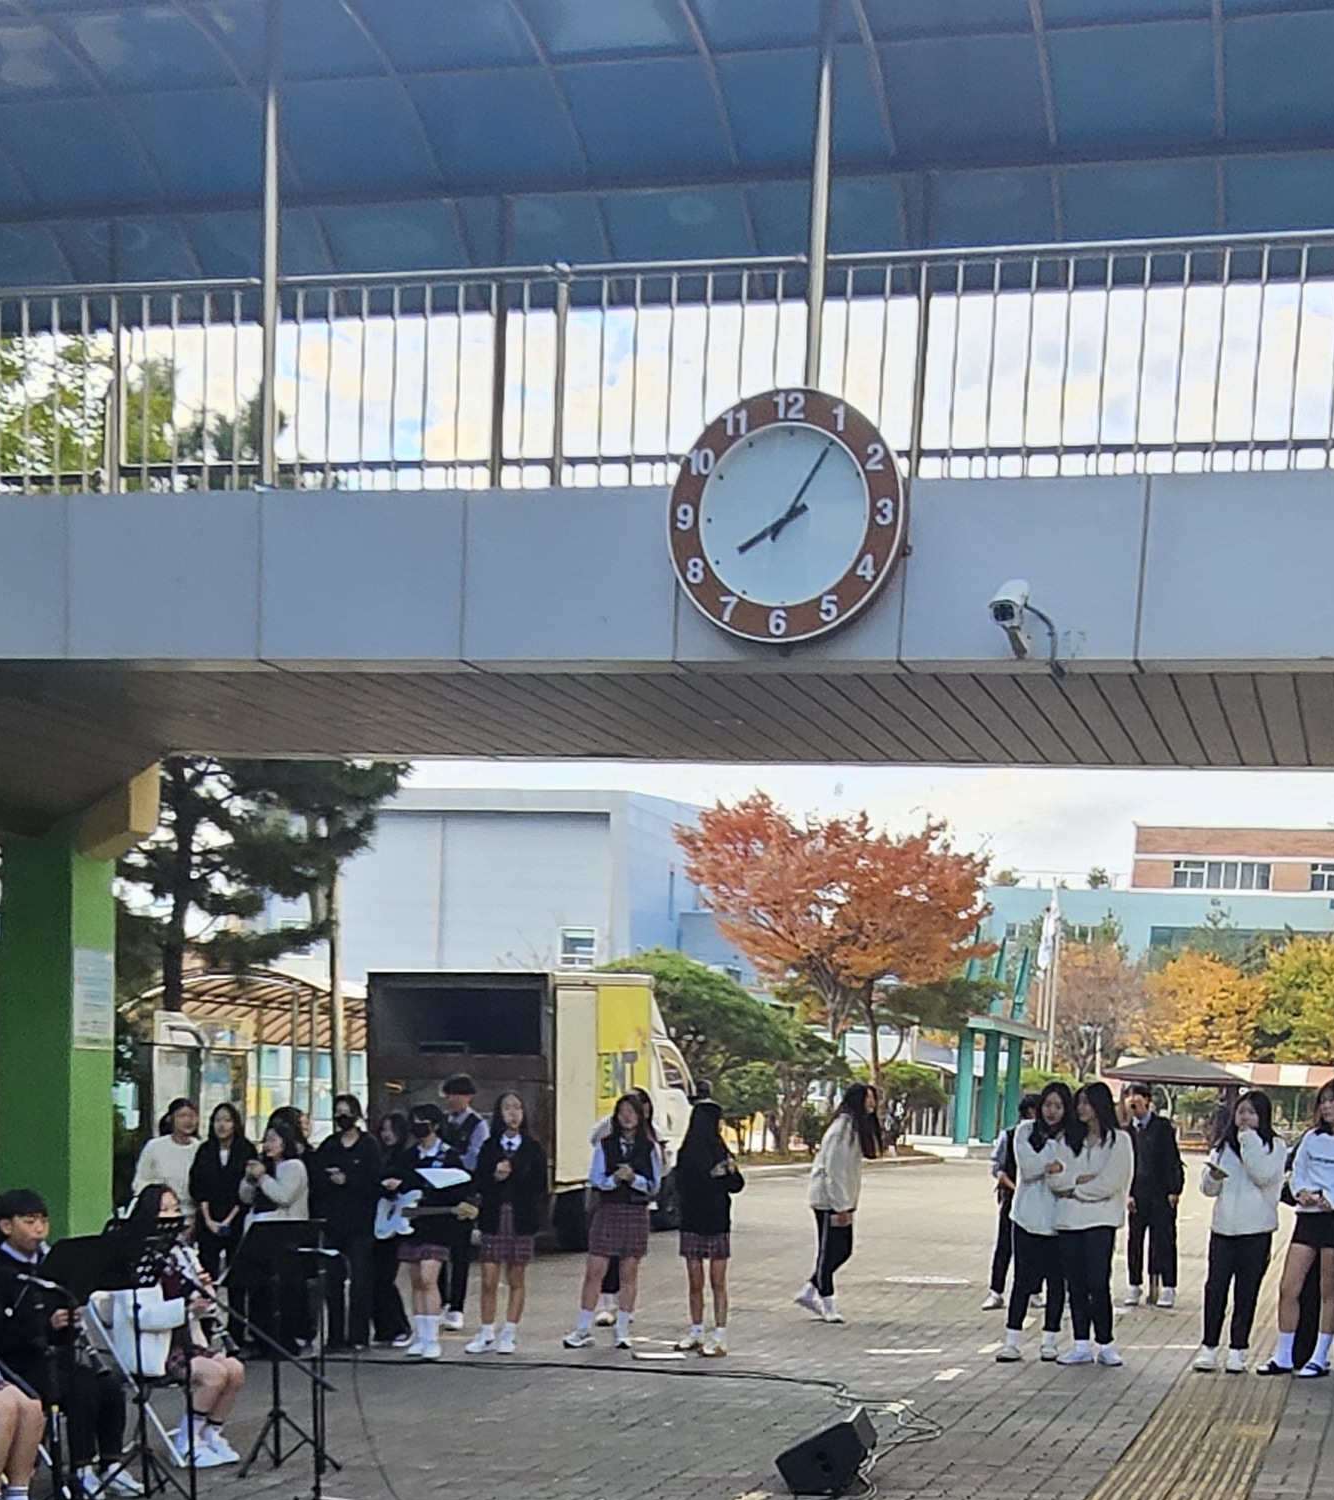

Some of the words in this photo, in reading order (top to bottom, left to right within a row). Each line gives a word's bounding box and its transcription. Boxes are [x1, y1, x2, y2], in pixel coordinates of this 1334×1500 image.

[773, 392, 804, 420] 12
[832, 405, 845, 432] 1
[722, 409, 748, 436] 11
[688, 448, 715, 476] 10
[865, 443, 884, 470] 2
[676, 503, 694, 531] 9
[875, 497, 893, 525] 3
[686, 557, 704, 584] 8
[856, 554, 875, 582] 4
[720, 595, 739, 622] 7
[820, 595, 838, 621] 5
[768, 609, 787, 635] 6
